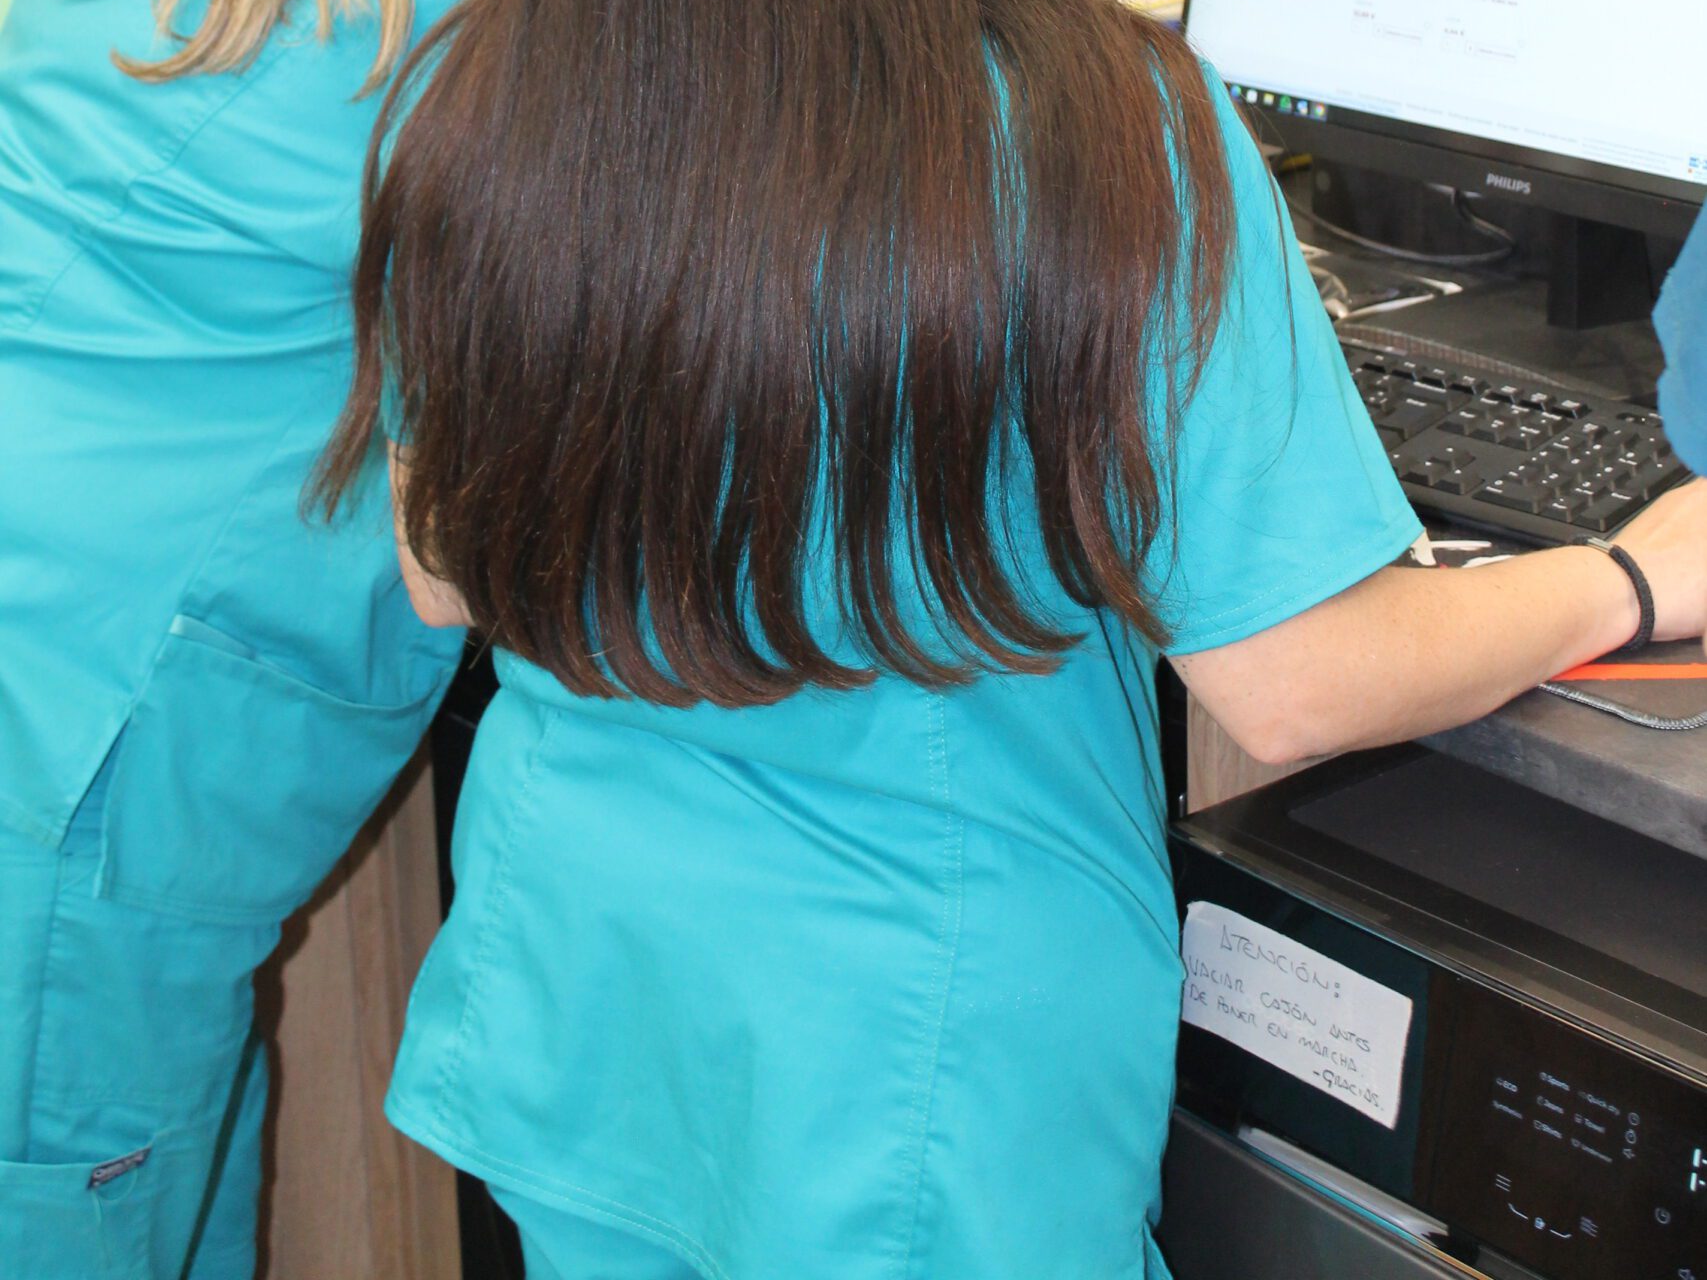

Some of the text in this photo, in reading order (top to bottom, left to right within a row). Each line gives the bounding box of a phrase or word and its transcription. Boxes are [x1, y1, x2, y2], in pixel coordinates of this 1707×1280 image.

[1486, 172, 1532, 195] PHILIPS
[1219, 923, 1341, 998] ATENCIÓN:
[1188, 955, 1371, 1053] VACIAR CAJÓN ANTES
[1189, 982, 1208, 1006] DE
[1216, 995, 1258, 1028] PONER
[1267, 1021, 1288, 1040] EN
